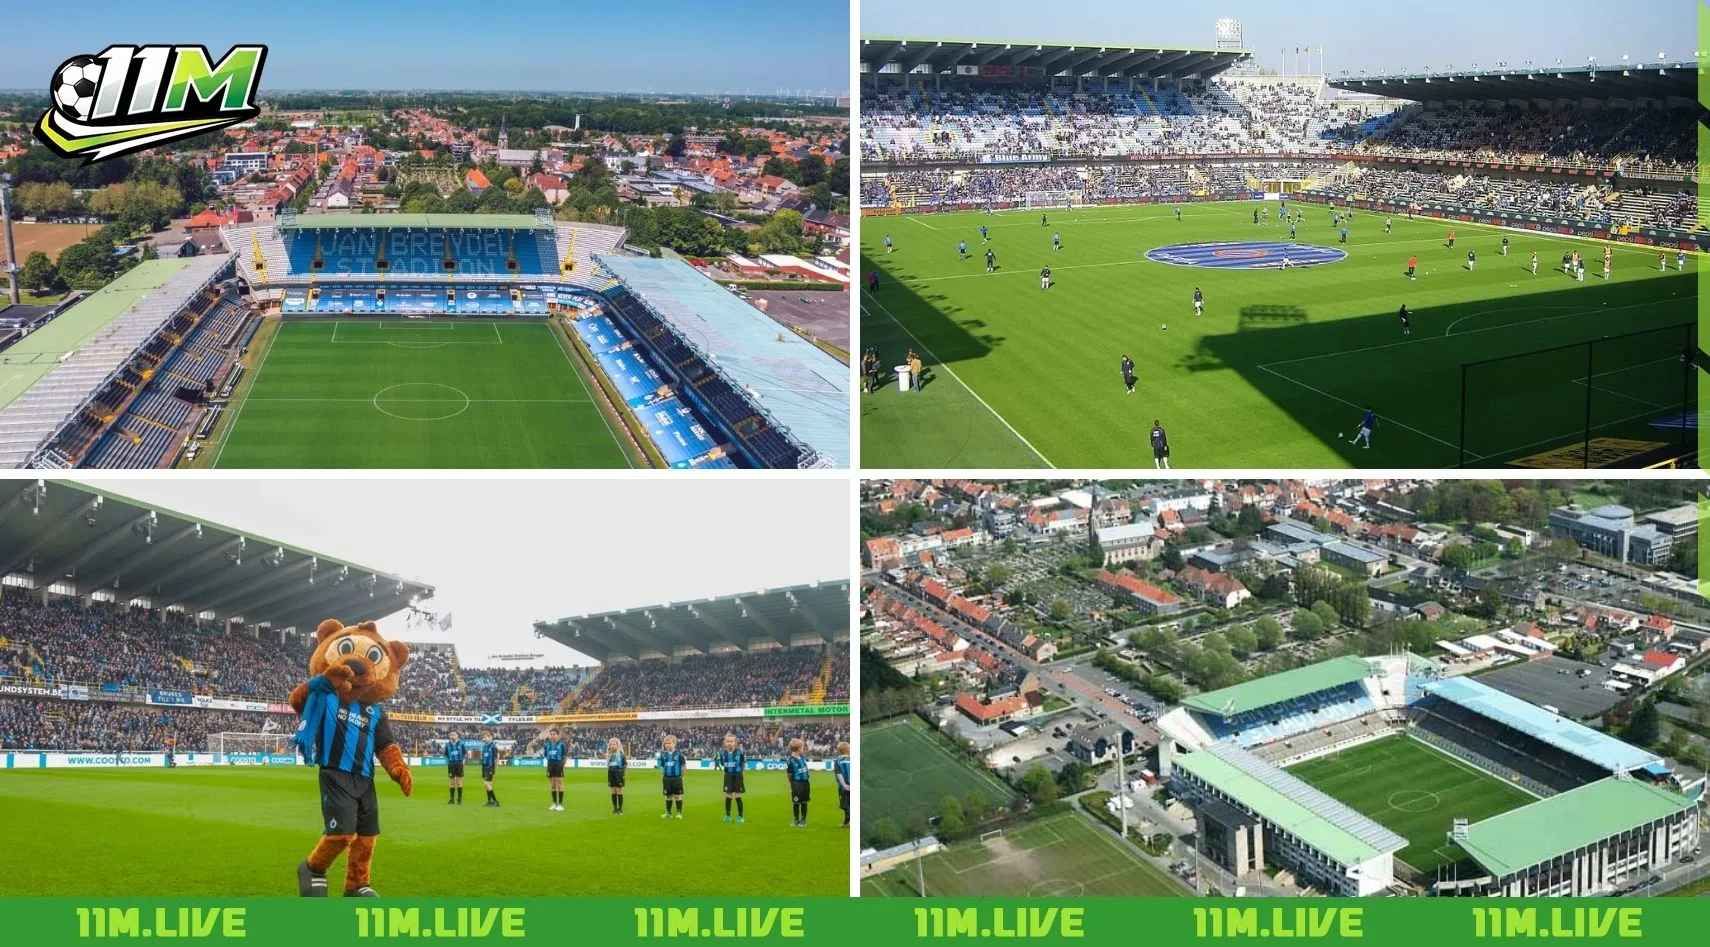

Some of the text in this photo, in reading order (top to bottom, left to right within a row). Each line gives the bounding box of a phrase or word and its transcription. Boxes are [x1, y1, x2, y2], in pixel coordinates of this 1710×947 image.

[1021, 154, 1048, 162] Army
[319, 232, 377, 256] JAN
[764, 707, 815, 715] INTERMETAL
[68, 756, 151, 765] WWW.COOO.COM
